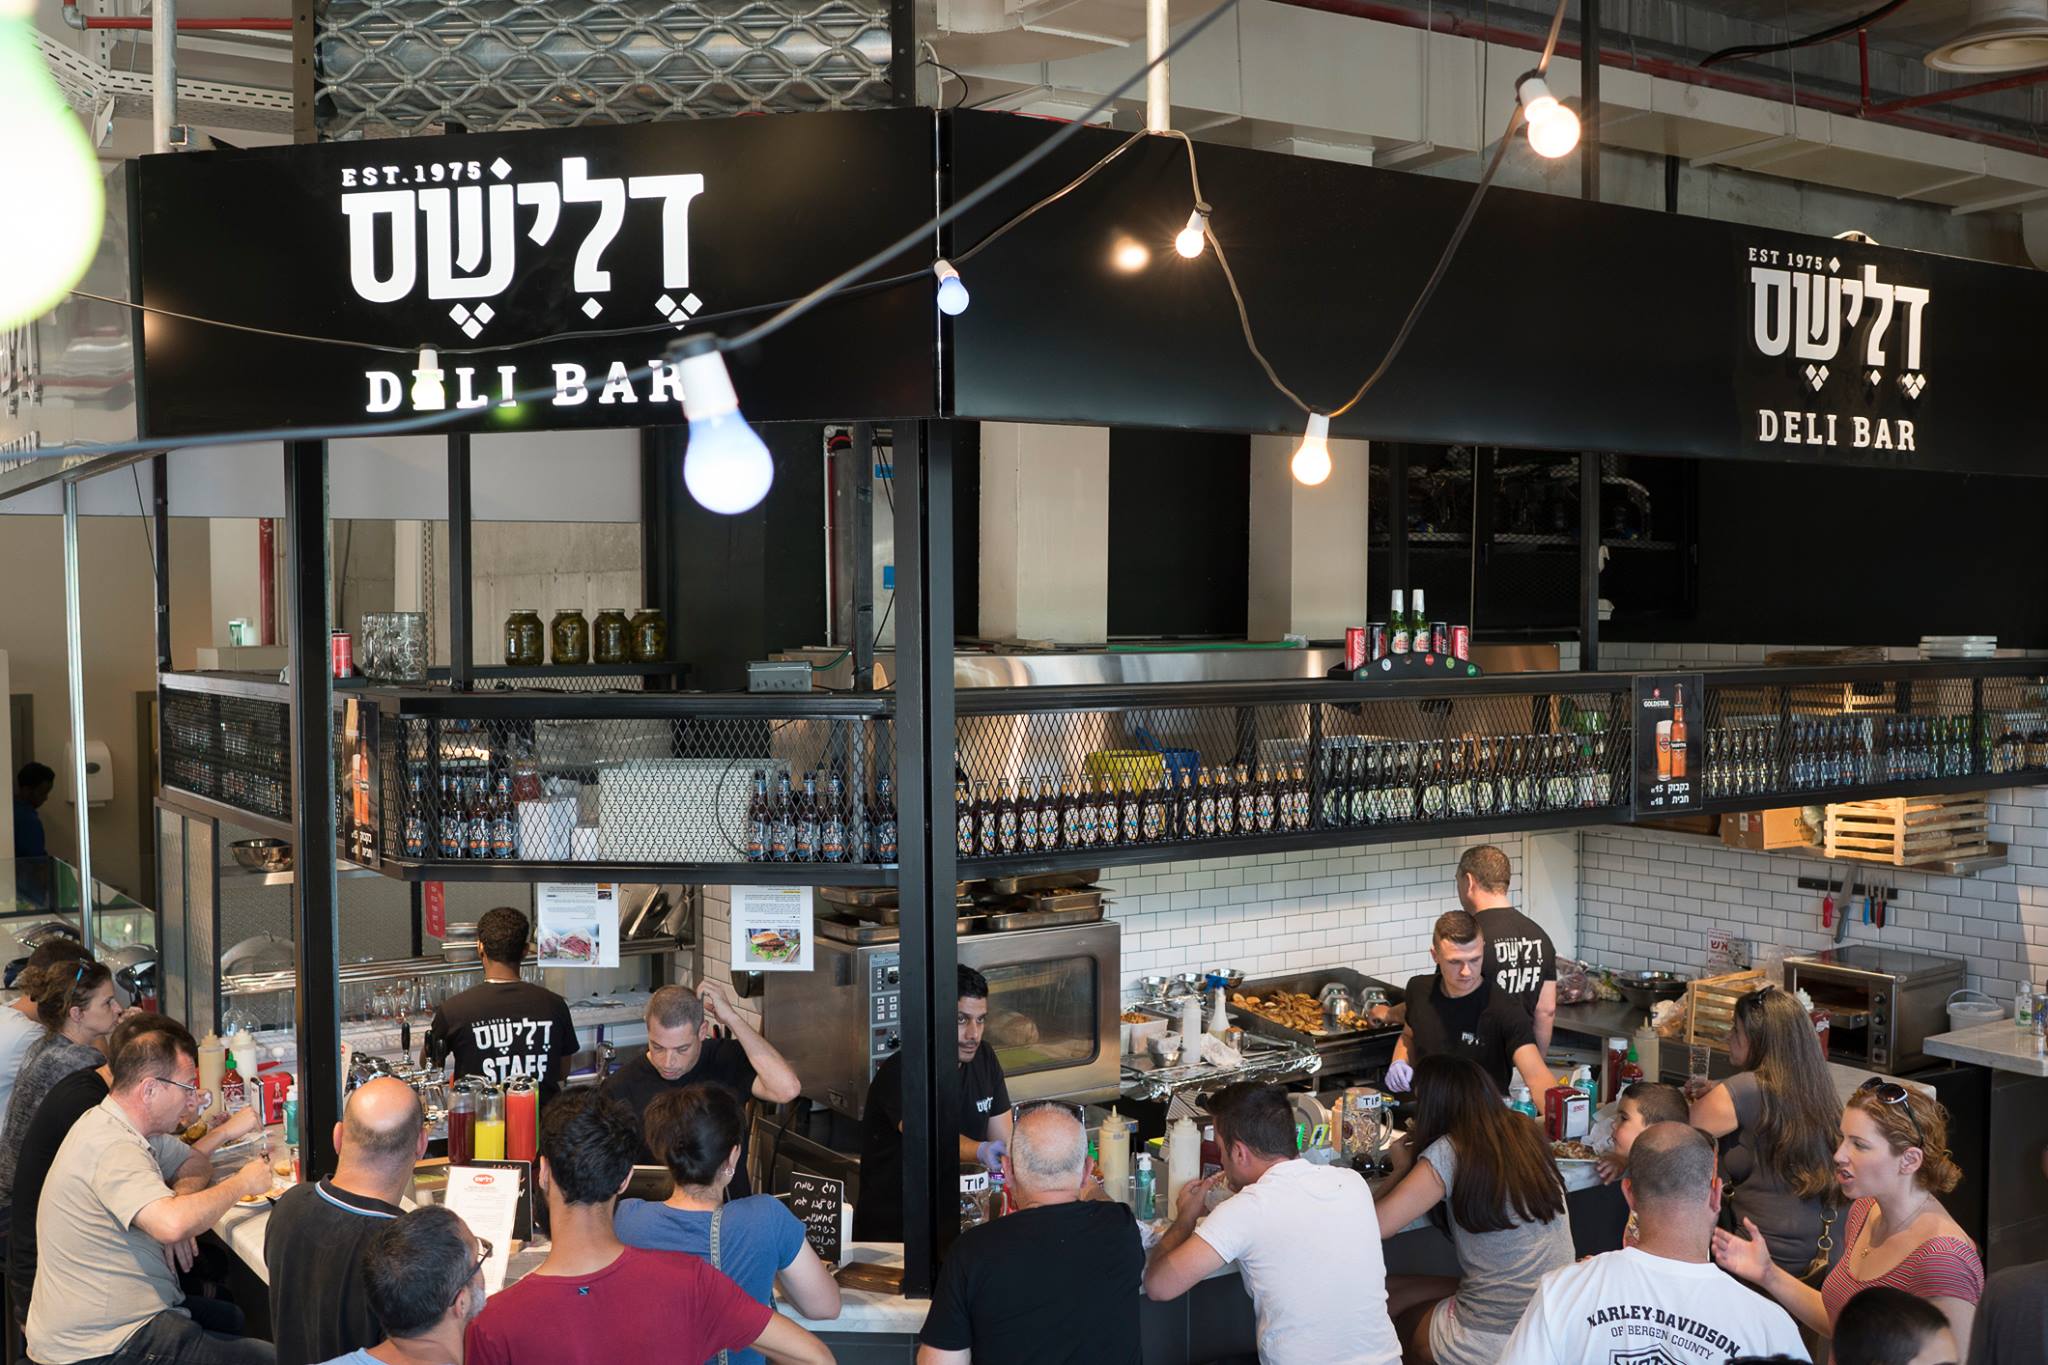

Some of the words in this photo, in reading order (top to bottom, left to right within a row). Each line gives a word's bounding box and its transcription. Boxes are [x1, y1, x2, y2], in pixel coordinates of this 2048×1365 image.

[1748, 247, 1780, 264] EST
[1787, 253, 1823, 270] 1975
[1759, 409, 1838, 446] DELI
[1852, 416, 1915, 451] BAR
[1643, 700, 1669, 708] GOLDSTAR
[1667, 783, 1690, 794] בקבוק
[1672, 795, 1690, 804] חבית
[482, 1054, 548, 1083] STAFF
[1363, 1096, 1380, 1106] TIP
[794, 1181, 814, 1191] שמח
[821, 1182, 836, 1194] חג
[965, 1177, 985, 1190] TIP
[1611, 1326, 1624, 1338] OF
[1628, 1325, 1668, 1340] BERGEN
[1671, 1334, 1714, 1360] COUNTY
